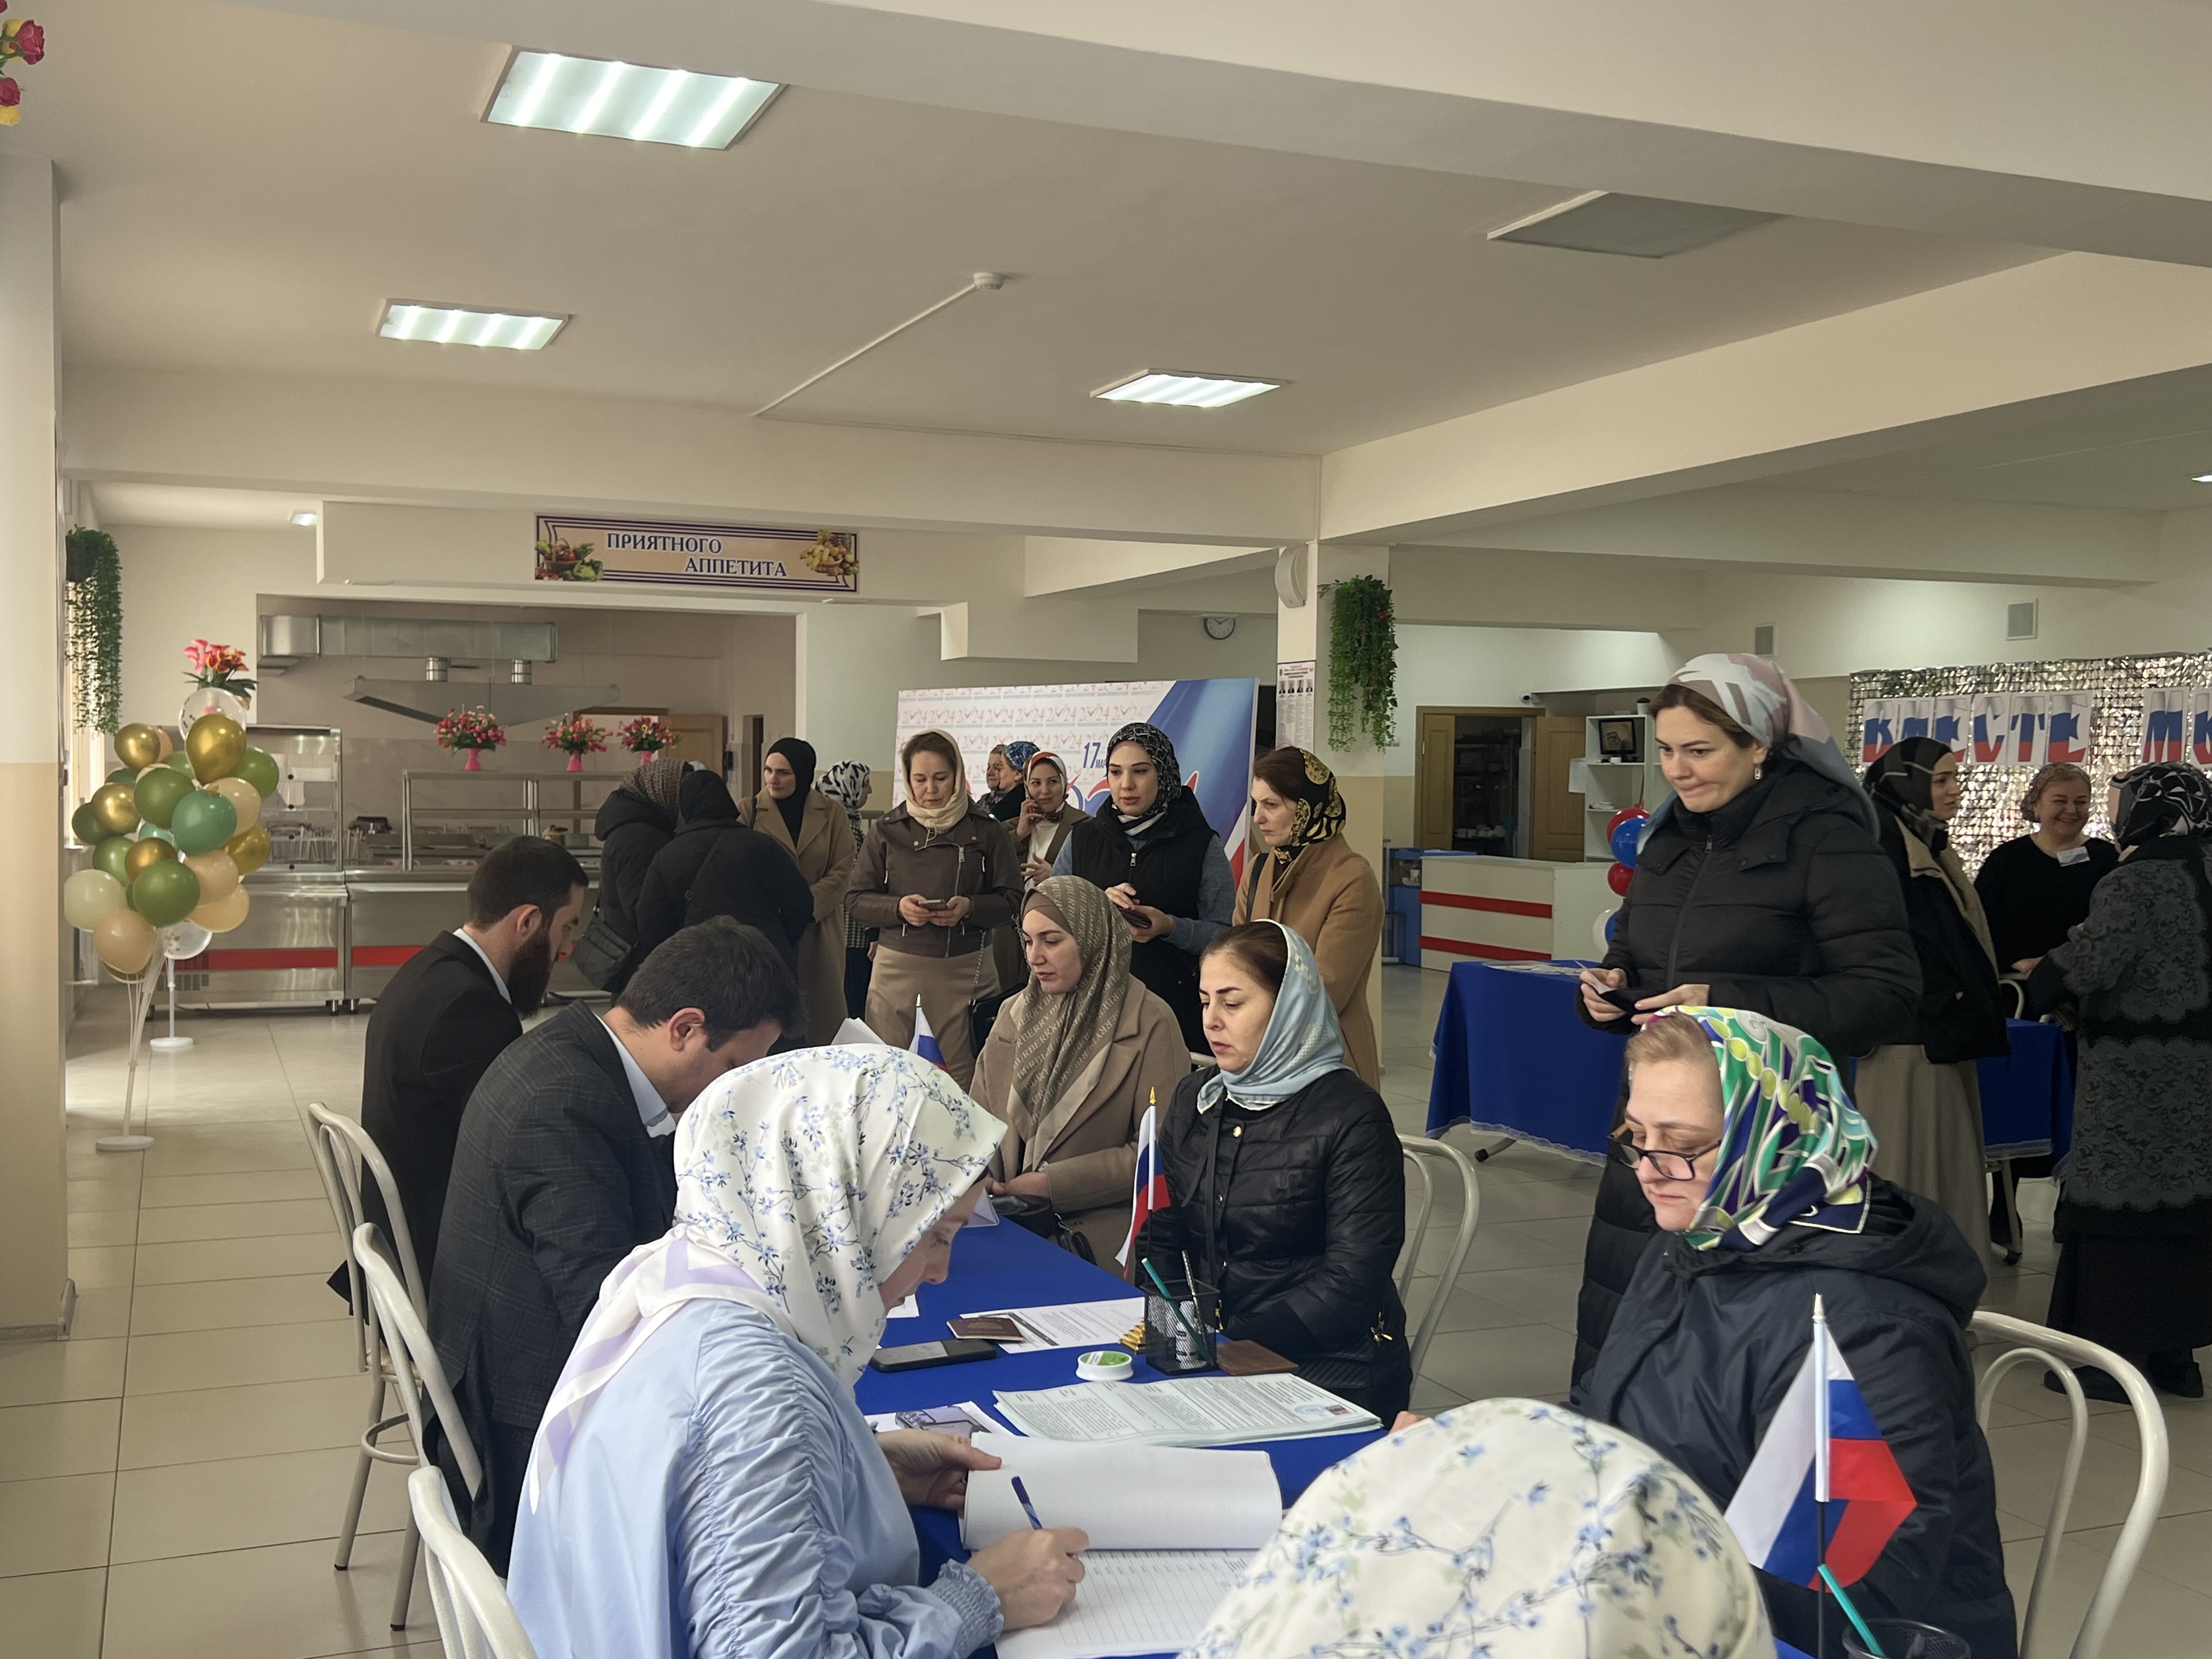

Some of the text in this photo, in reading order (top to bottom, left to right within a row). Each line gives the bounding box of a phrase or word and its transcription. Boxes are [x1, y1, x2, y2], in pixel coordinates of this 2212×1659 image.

[607, 533, 722, 554] ПРИЯТНОГО
[685, 557, 787, 577] АППЕТИТА
[1862, 690, 2086, 764] ВМЕСТЕ
[1083, 742, 1101, 768] 17
